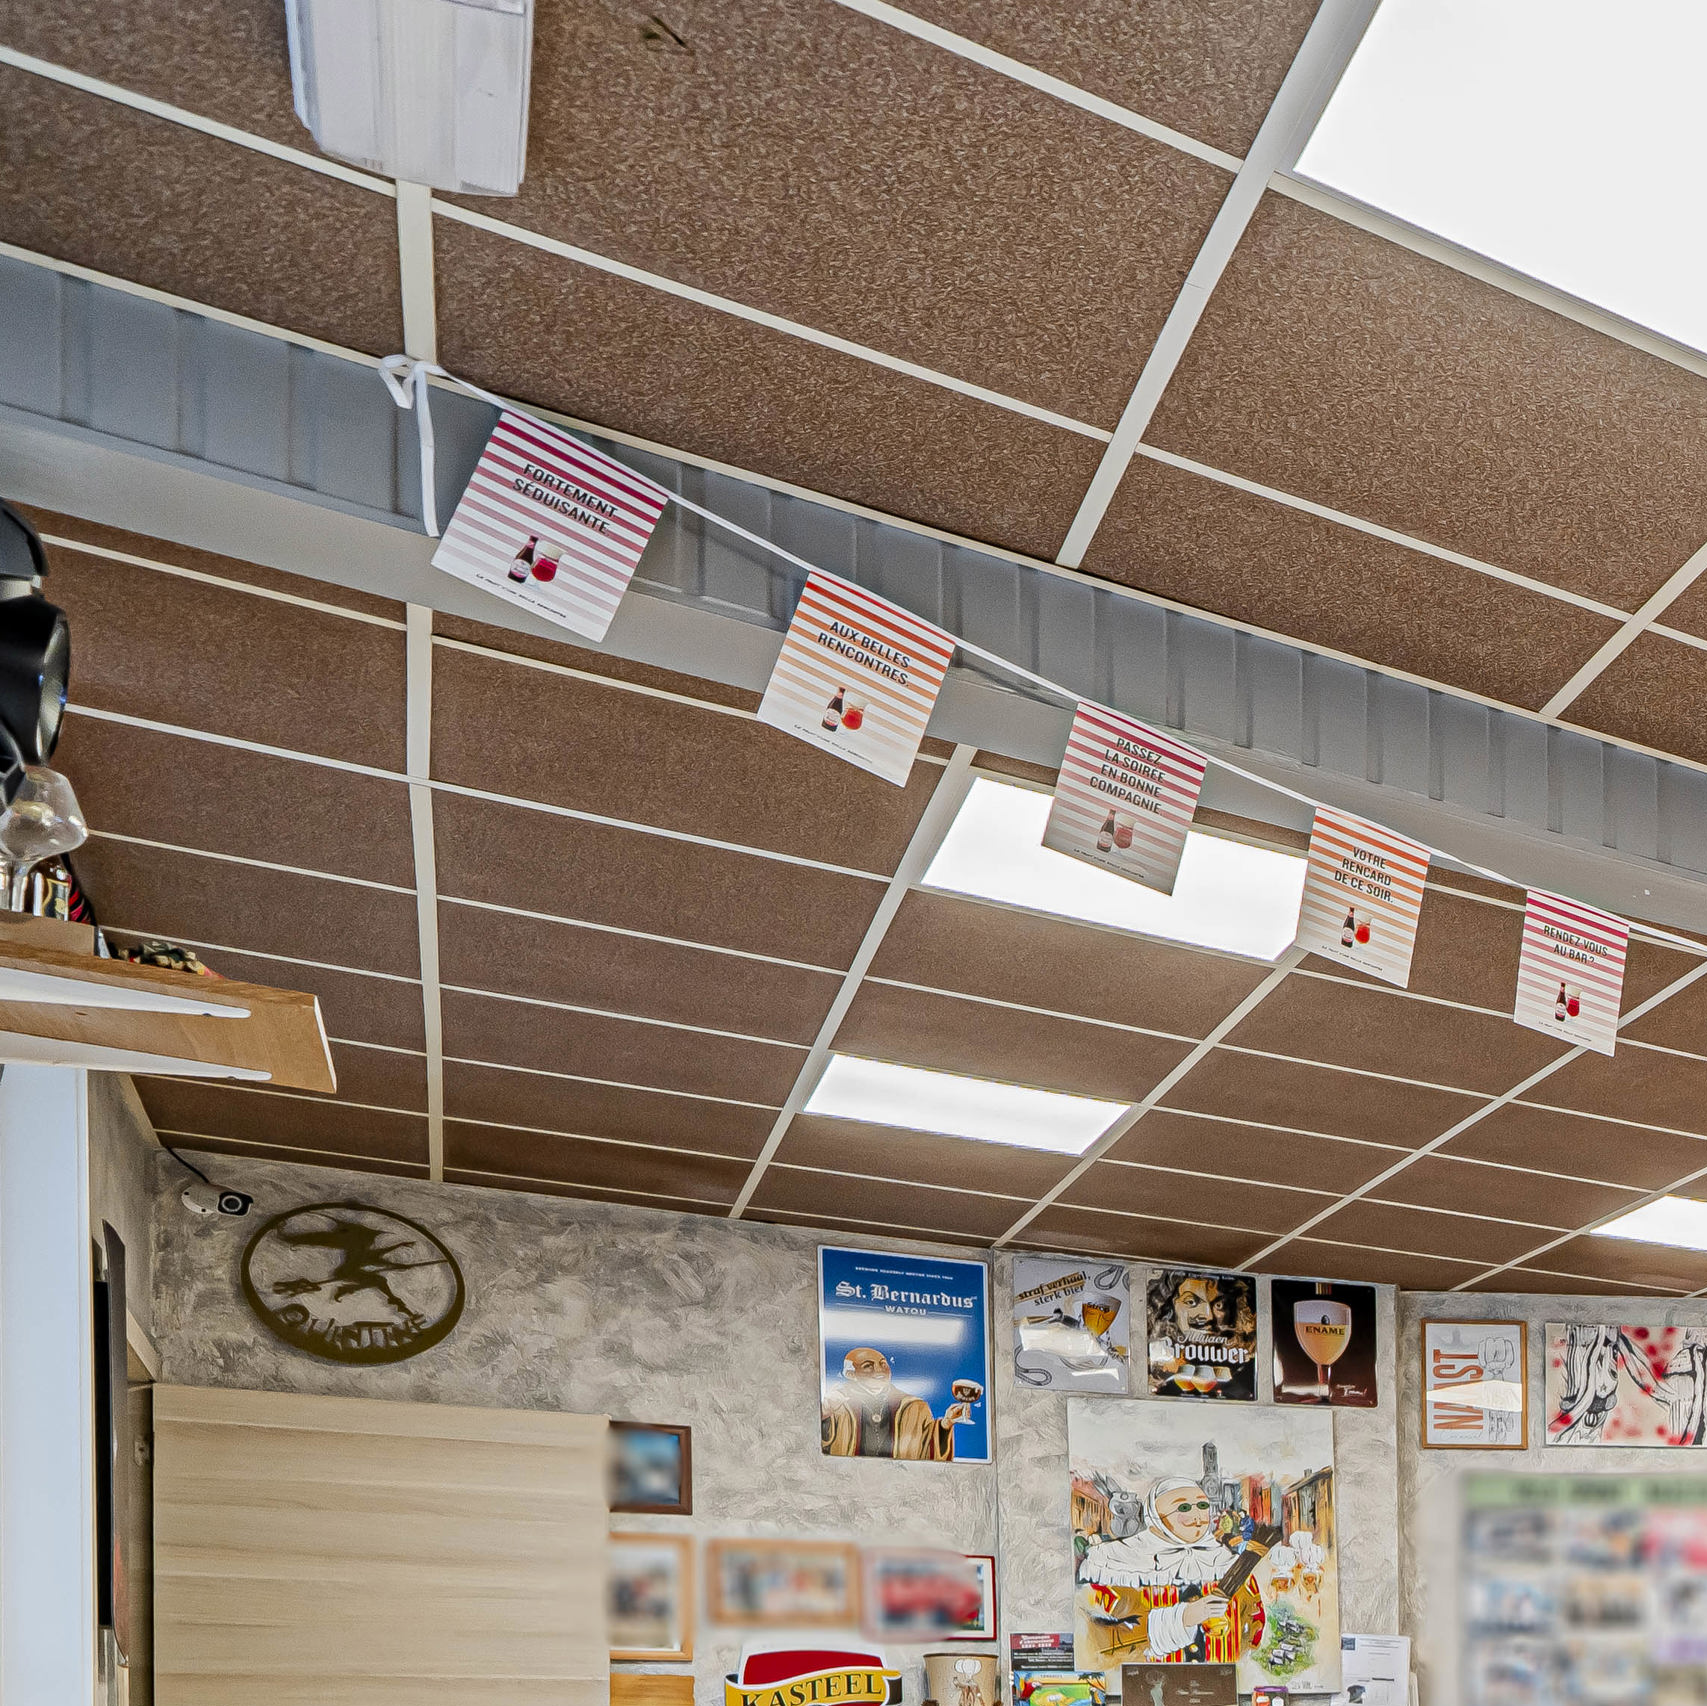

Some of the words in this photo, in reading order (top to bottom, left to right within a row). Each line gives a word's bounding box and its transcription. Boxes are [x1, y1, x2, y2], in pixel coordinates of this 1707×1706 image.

[523, 463, 618, 518] FORTEMENT
[830, 621, 860, 644] AUX
[860, 636, 911, 669] BELLES
[817, 632, 910, 687] RENCONTRES.
[1116, 737, 1162, 765] PASSEZ
[1105, 749, 1119, 764] LA
[1122, 756, 1166, 784] SOIRÉE
[1100, 764, 1118, 780] EN
[1120, 772, 1162, 798] BONNE
[1342, 858, 1392, 886] RENCARD
[1352, 847, 1387, 869] VOTRE
[1334, 870, 1348, 885] DE
[1350, 876, 1363, 892] CE
[1366, 883, 1394, 903] SOIR.
[1543, 925, 1609, 957] RENDEZ-VOUS
[1553, 943, 1567, 956] AU
[1569, 949, 1588, 964] BAR
[835, 1281, 867, 1299] St.
[870, 1283, 974, 1309] Bernardus
[1019, 1283, 1045, 1300] straf
[1034, 1291, 1062, 1306] sterk
[1064, 1285, 1085, 1297] bier
[884, 1304, 927, 1316] WATOU
[1305, 1325, 1345, 1336] ENAME
[1161, 1335, 1249, 1365] Brouwer
